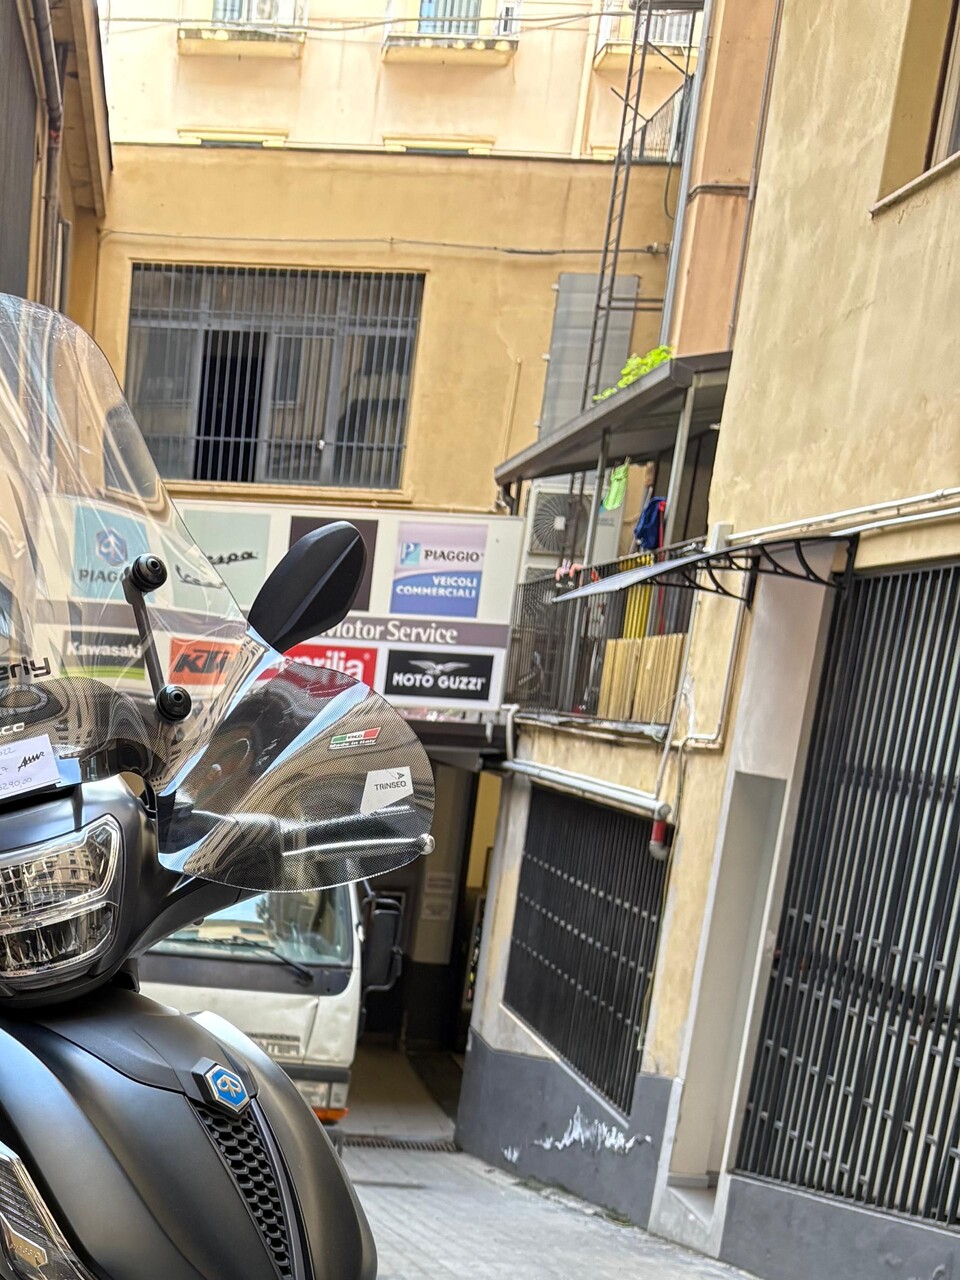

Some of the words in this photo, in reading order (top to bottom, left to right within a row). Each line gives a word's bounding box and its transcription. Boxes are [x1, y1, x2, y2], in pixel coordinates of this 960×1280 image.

[424, 549, 480, 562] PIAGGIO
[432, 575, 477, 588] VEICOLI
[395, 585, 477, 598] COMMERCIALI
[386, 619, 458, 644] Service
[66, 640, 143, 659] Kawasaki
[392, 672, 434, 688] MOTO
[437, 674, 484, 691] GUZZI
